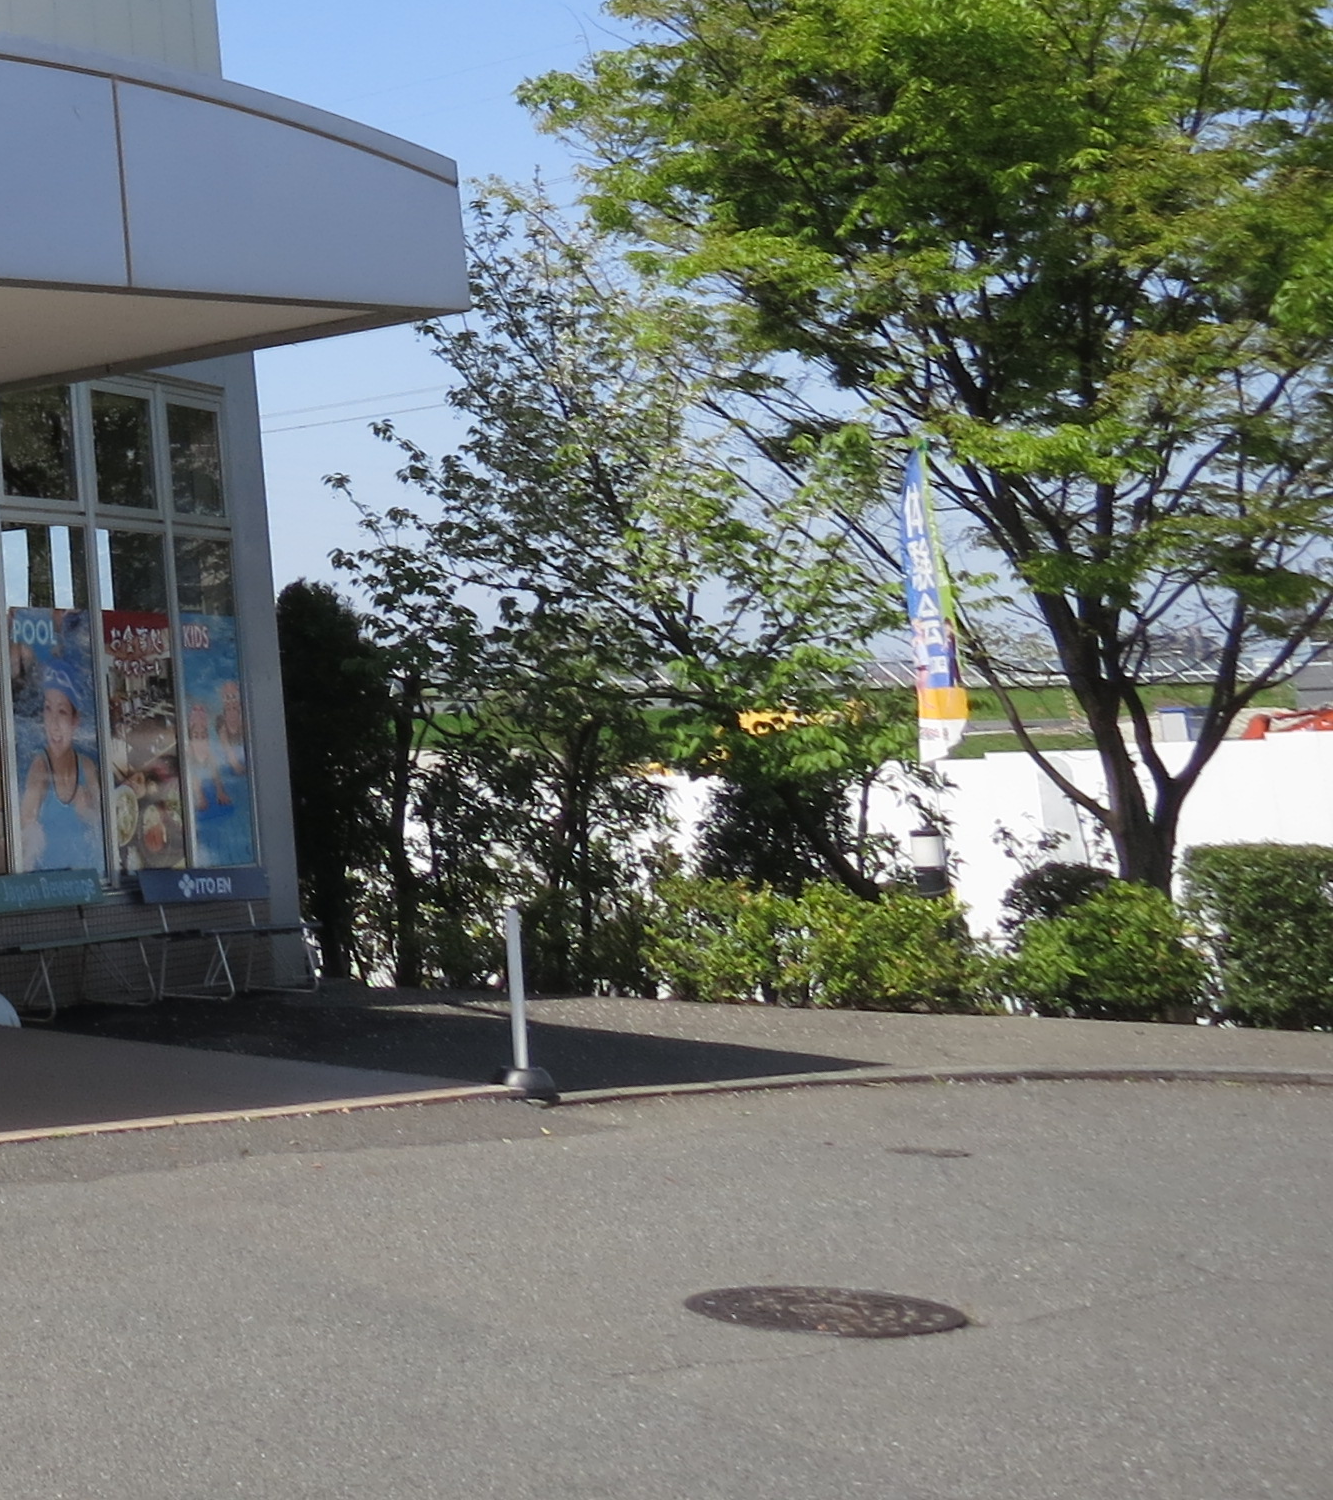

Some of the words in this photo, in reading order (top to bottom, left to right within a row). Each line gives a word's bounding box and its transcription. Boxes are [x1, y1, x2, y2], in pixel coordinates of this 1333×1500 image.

[13, 619, 57, 645] POOL
[182, 625, 210, 648] KIDS
[39, 877, 97, 902] Beverage
